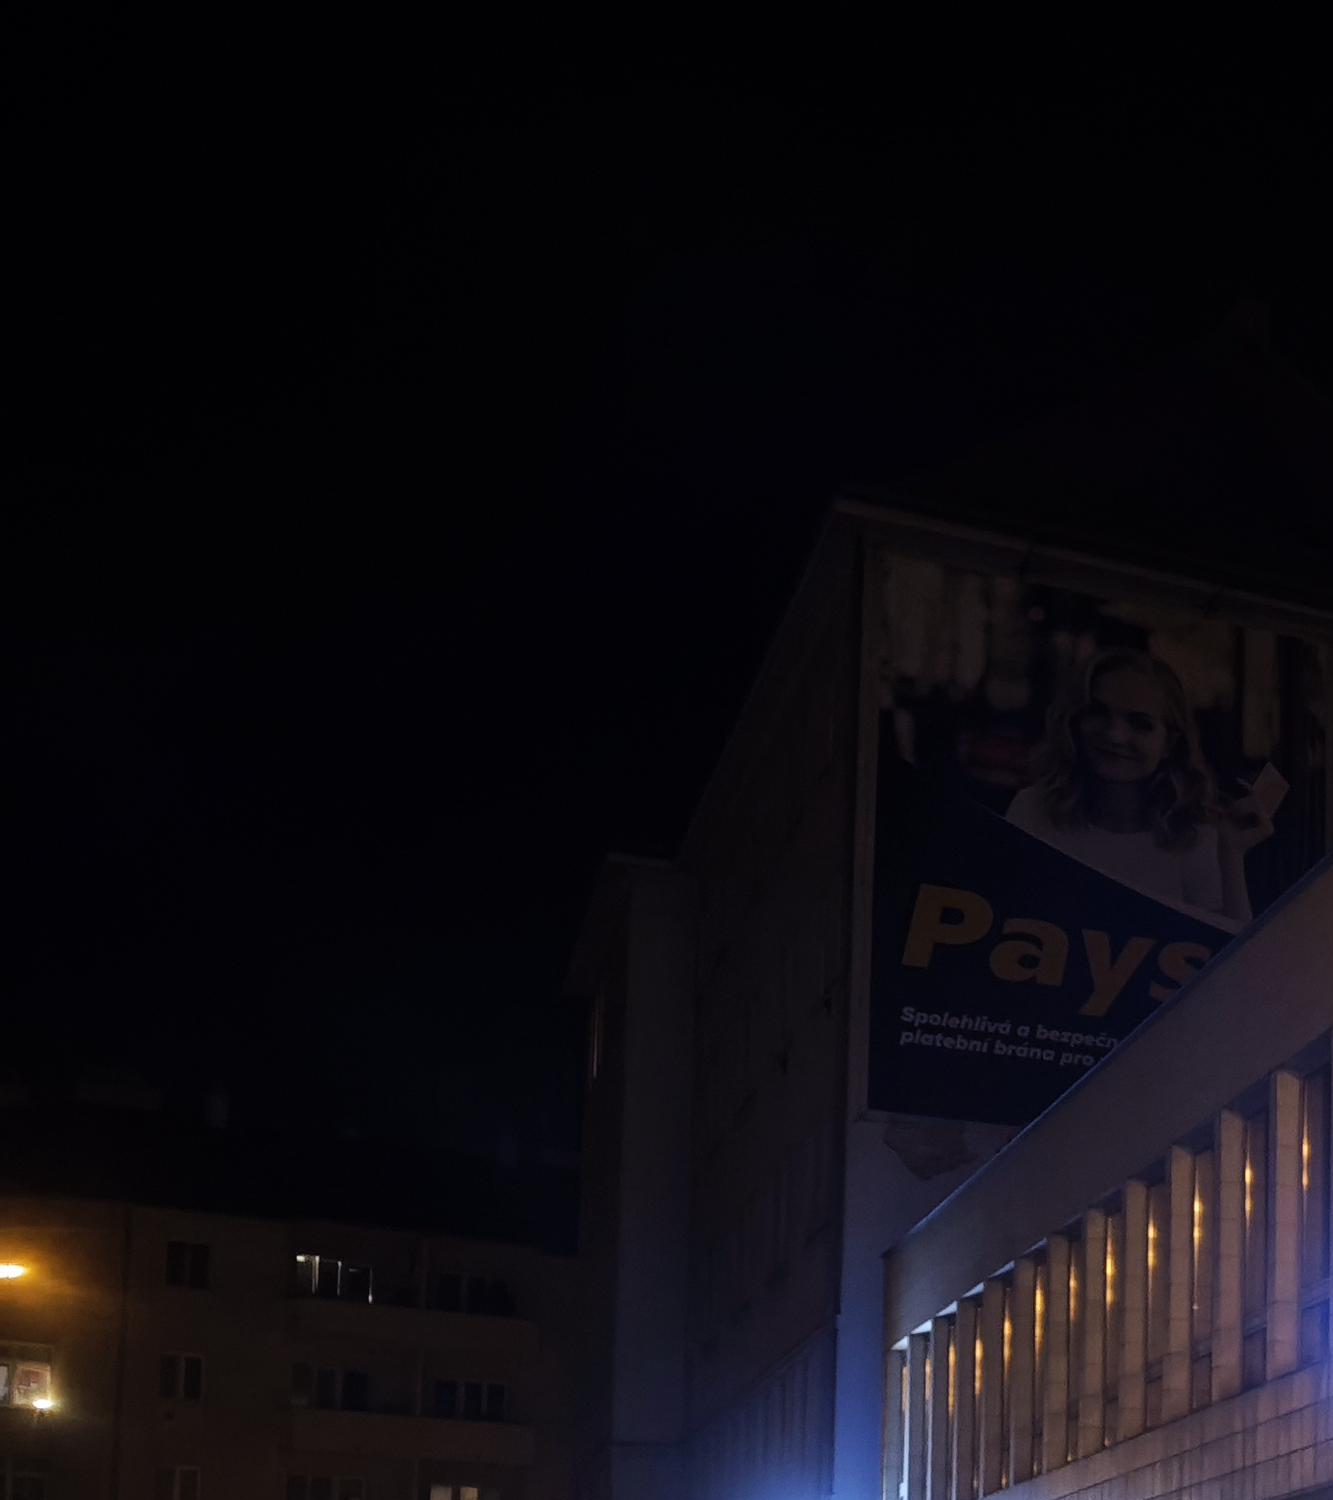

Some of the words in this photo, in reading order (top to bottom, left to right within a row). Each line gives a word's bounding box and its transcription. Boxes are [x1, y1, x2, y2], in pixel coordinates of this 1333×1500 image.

[900, 1005, 1012, 1038] Spolehlivá
[1016, 1023, 1031, 1038] a
[899, 1029, 989, 1054] platební
[993, 1039, 1056, 1062] brána
[1059, 1050, 1095, 1067] pro
